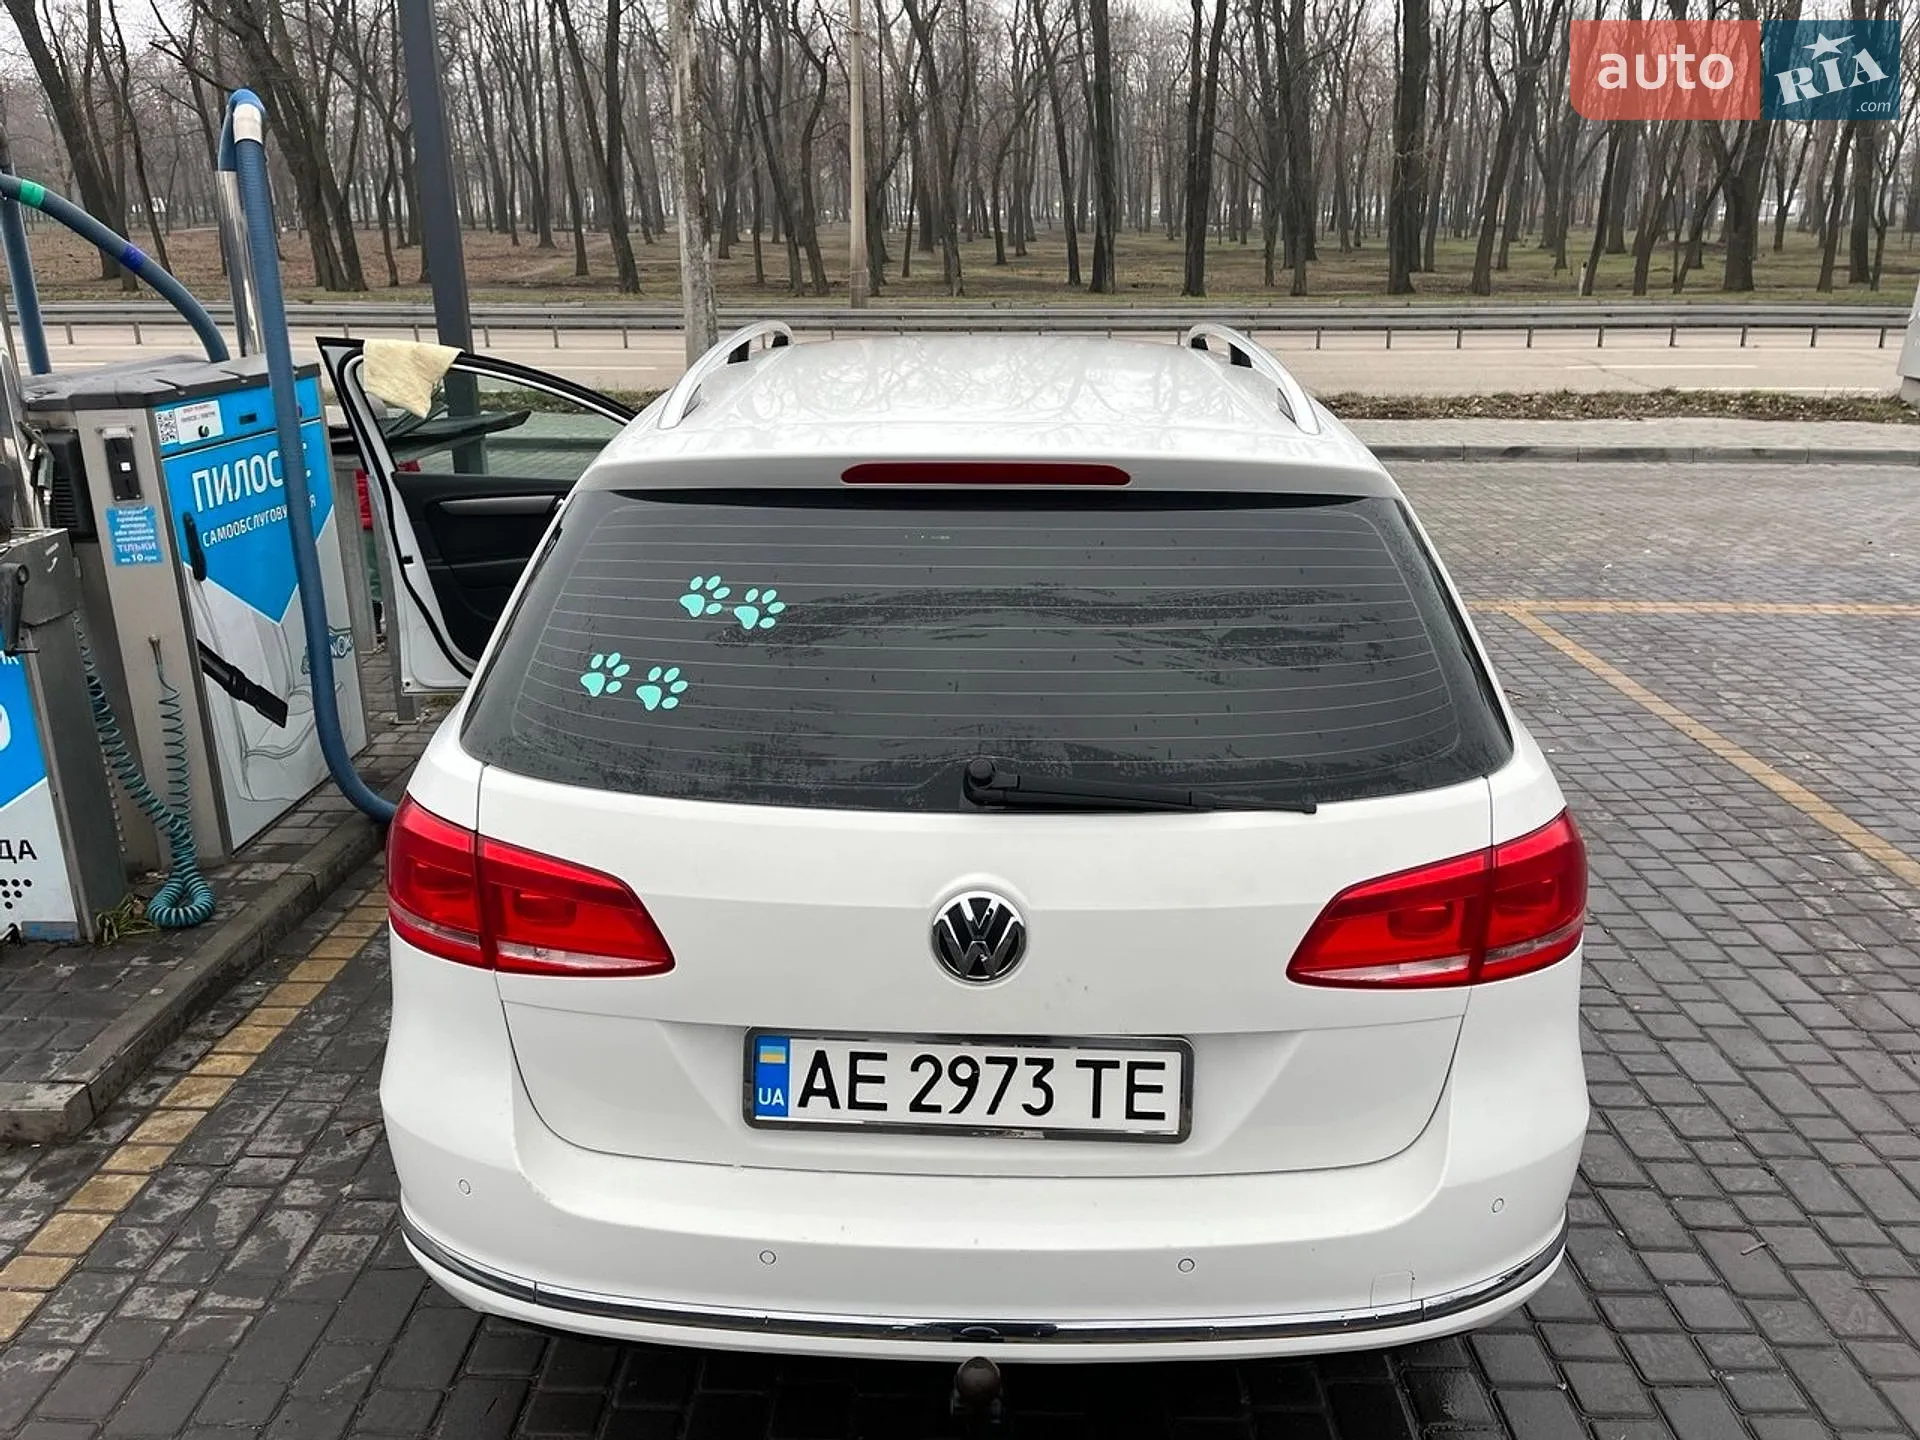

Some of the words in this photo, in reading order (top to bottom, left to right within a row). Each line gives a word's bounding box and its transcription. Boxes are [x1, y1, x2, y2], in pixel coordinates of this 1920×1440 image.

[192, 442, 312, 512] ПИЛОС
[202, 494, 316, 547] САМООБСЛУГОВУЯ
[131, 553, 144, 562] 10
[758, 1086, 784, 1107] UA
[797, 1050, 888, 1112] AE
[908, 1053, 1055, 1117] 2973
[1075, 1059, 1166, 1121] TE
